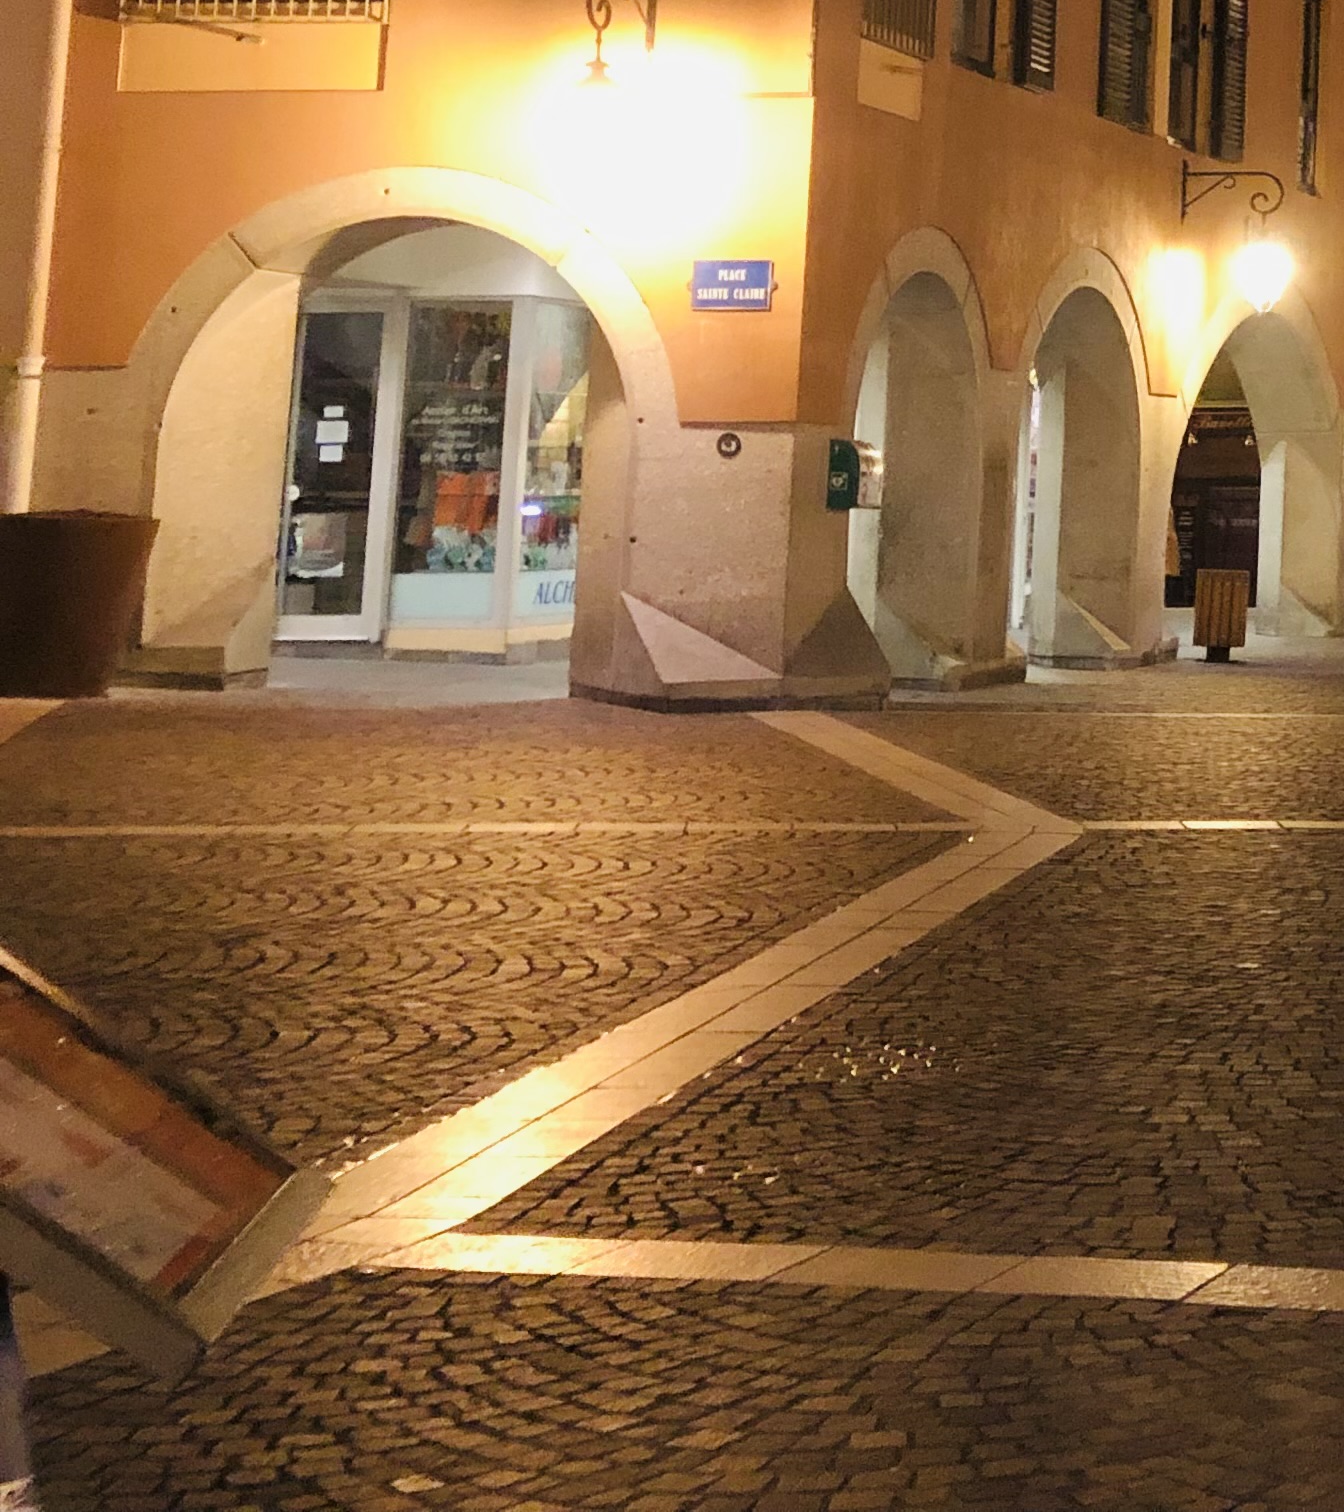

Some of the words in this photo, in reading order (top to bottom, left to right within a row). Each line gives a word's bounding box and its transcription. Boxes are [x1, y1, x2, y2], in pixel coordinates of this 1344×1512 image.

[718, 269, 747, 281] PLACE
[696, 288, 729, 300] SAINTE
[733, 288, 766, 300] CLAIRE
